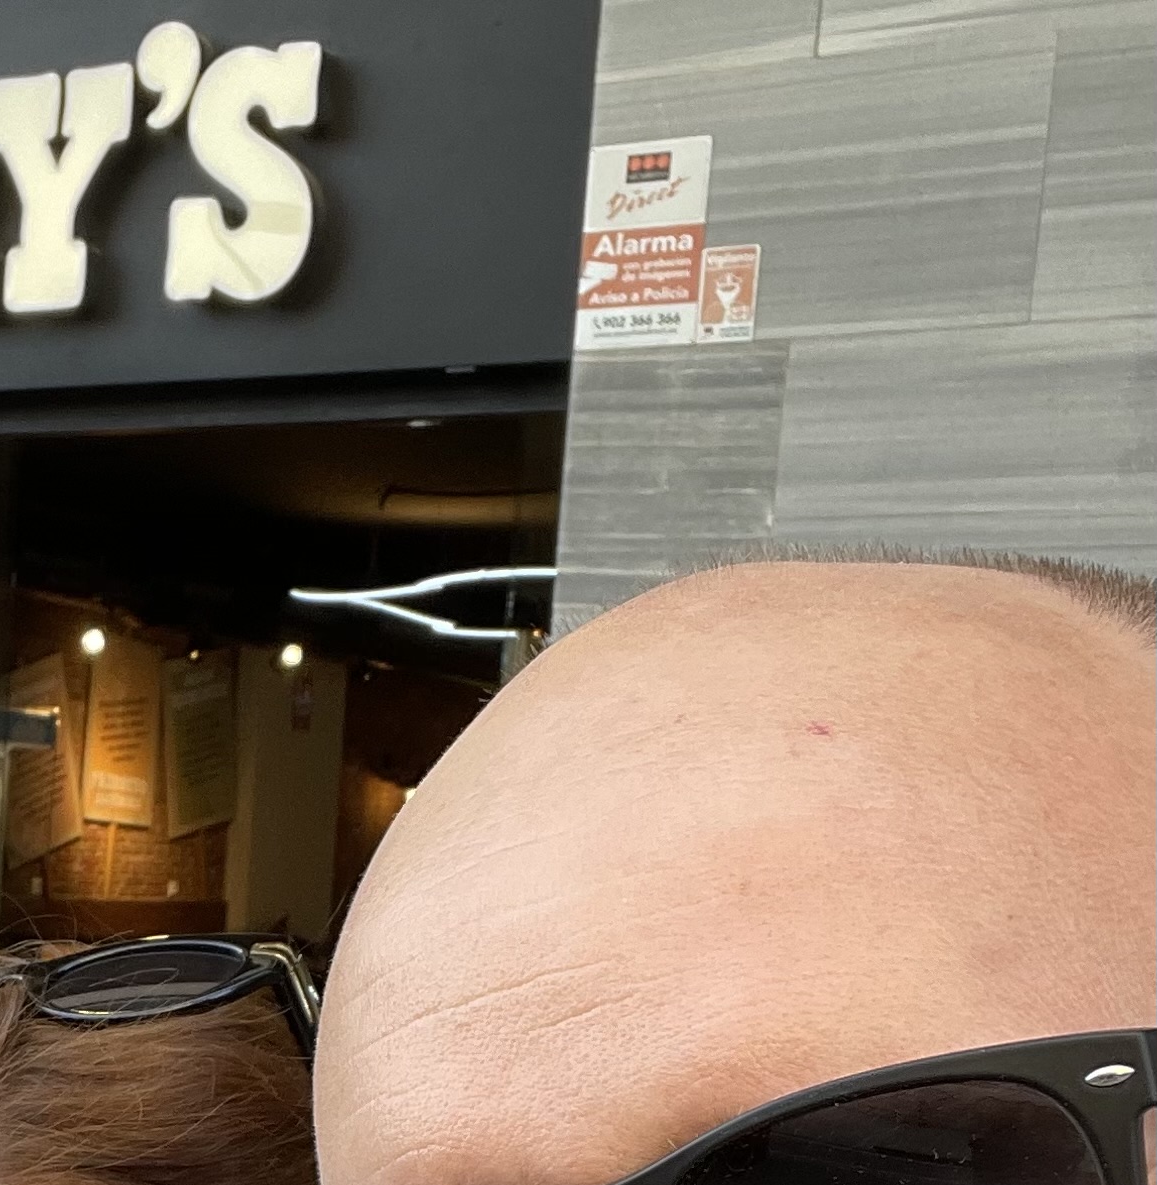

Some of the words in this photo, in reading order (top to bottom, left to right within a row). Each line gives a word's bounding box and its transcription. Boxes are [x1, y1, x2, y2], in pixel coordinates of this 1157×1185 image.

[593, 232, 694, 258] Alarma
[589, 290, 628, 305] Aviso
[629, 292, 641, 303] a
